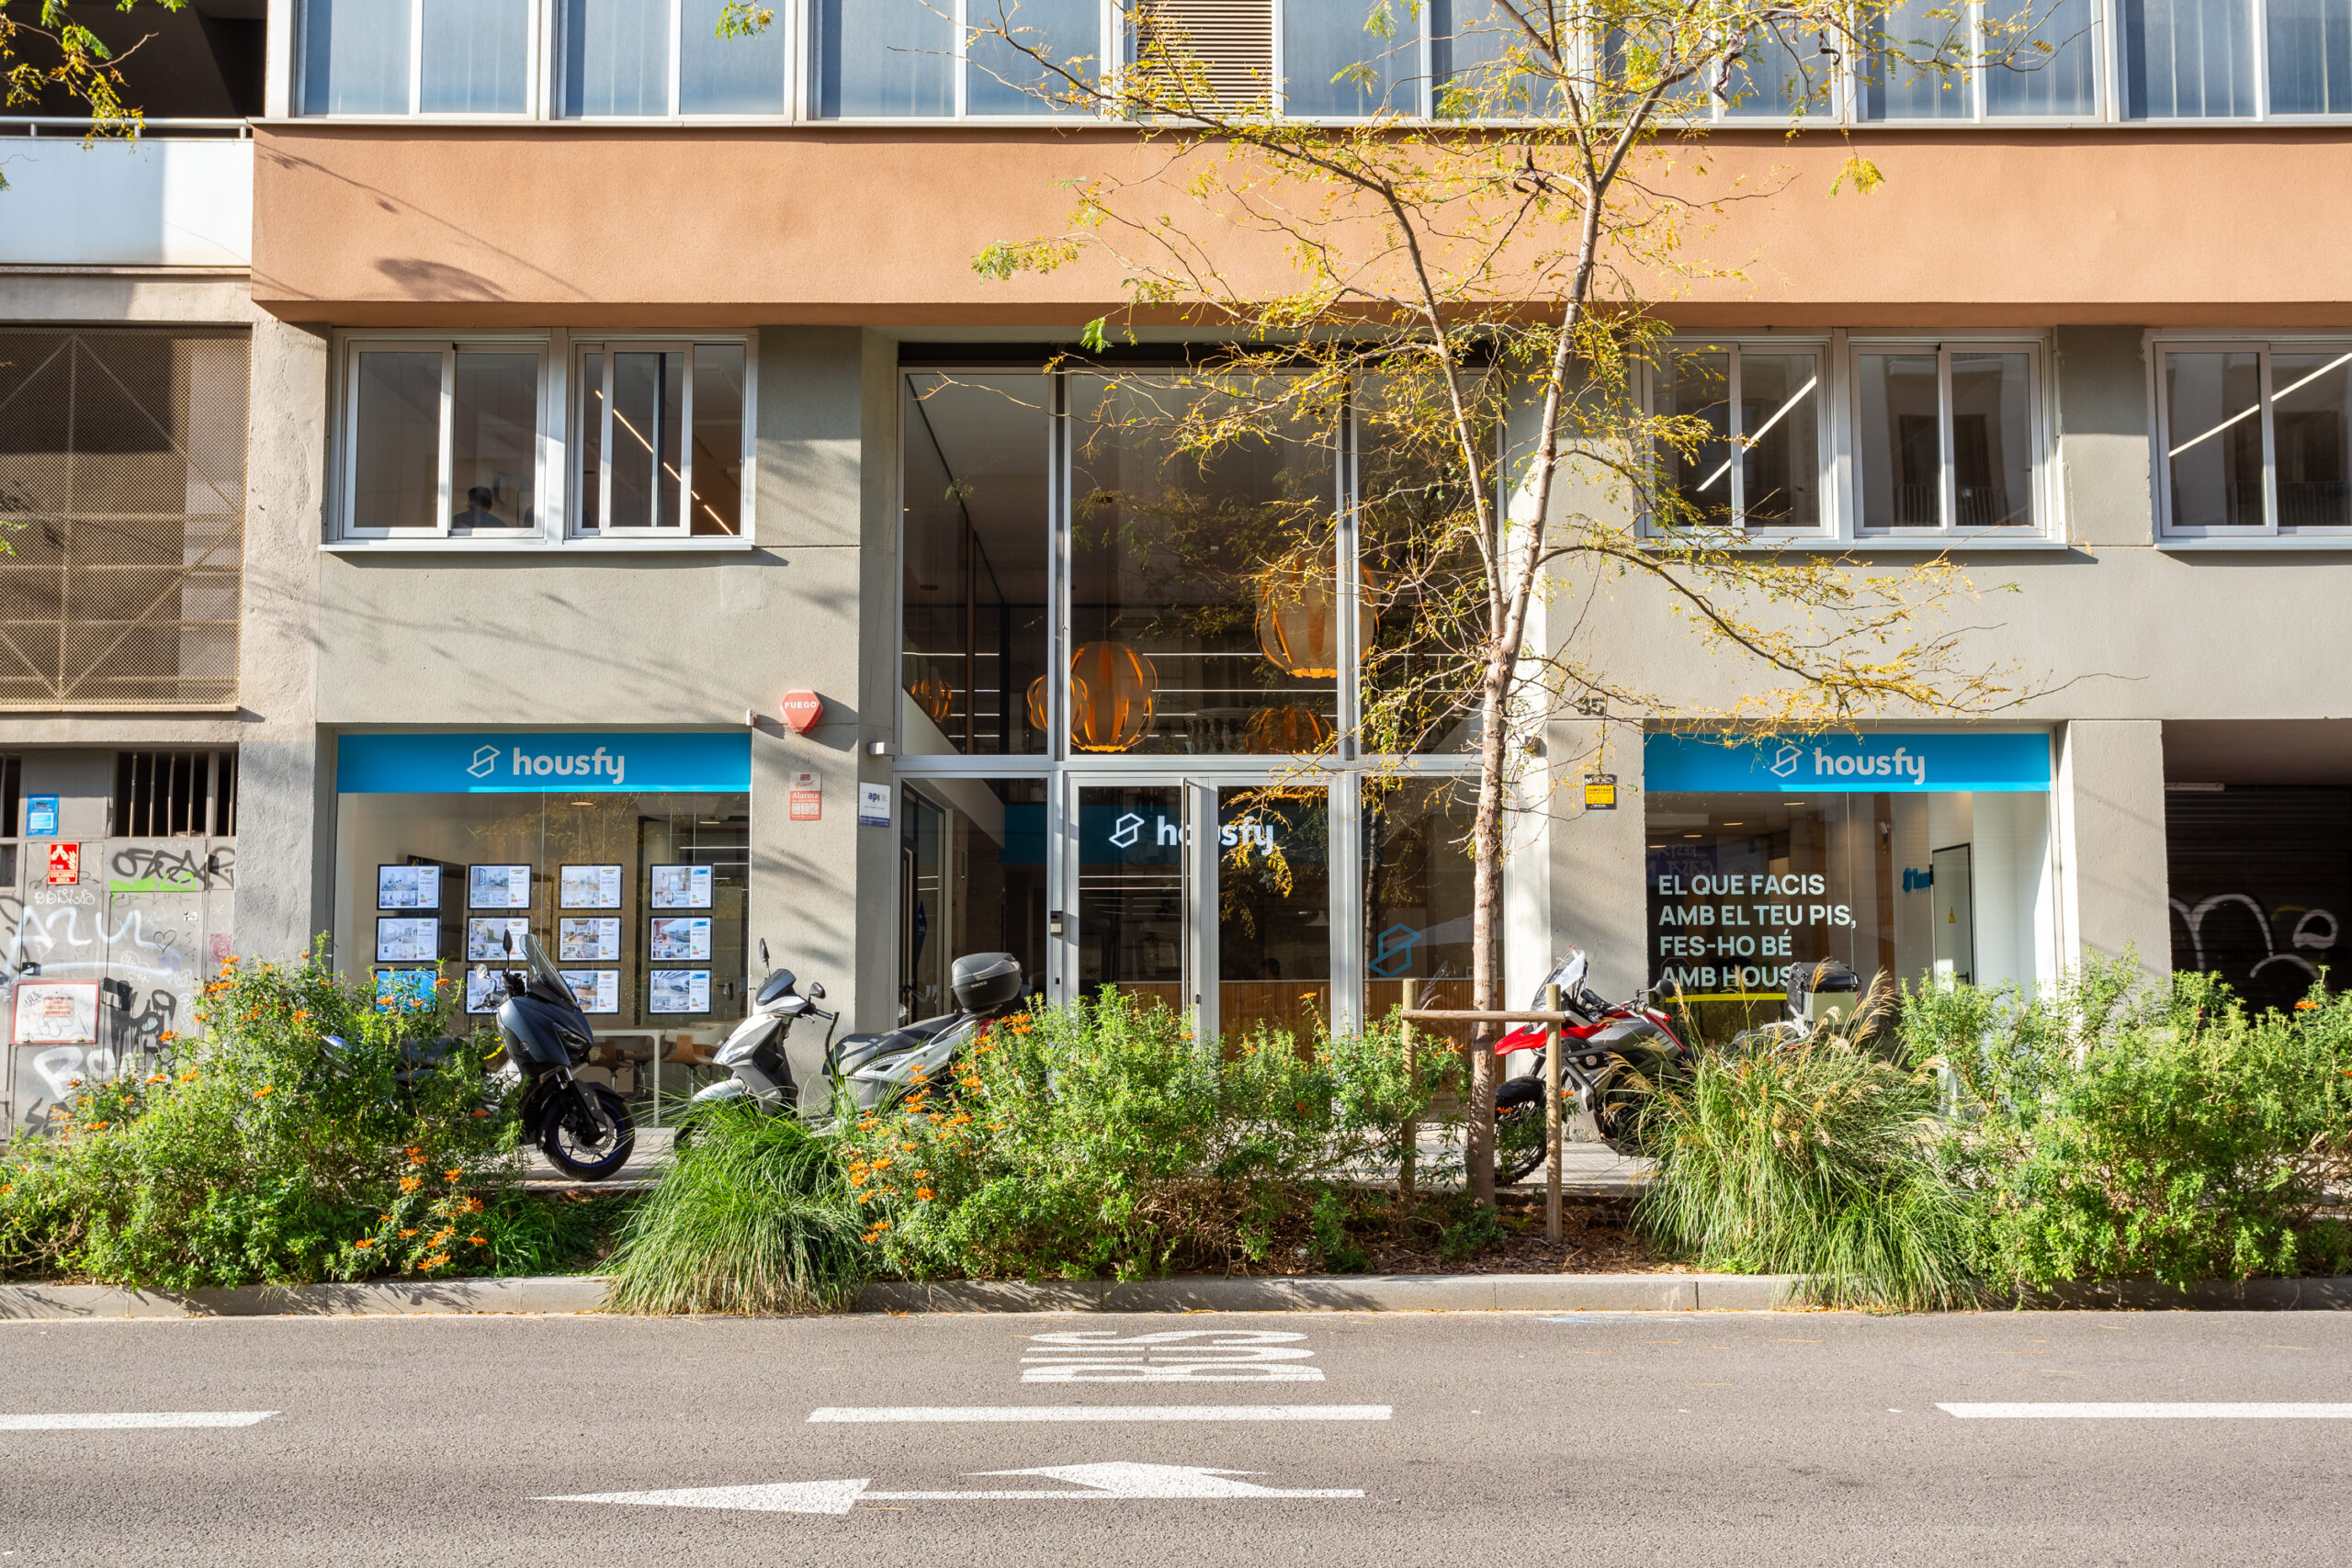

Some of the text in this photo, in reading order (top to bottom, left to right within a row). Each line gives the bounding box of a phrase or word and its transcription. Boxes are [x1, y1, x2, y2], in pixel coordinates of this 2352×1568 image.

[784, 701, 817, 709] FUEGO
[513, 746, 625, 785] housfy
[1815, 746, 1926, 785] housfy
[1157, 815, 1273, 856] hsfy
[1658, 874, 1826, 896] EL QUE FACIS
[1658, 905, 1857, 929] AMB EL TEU PIS,
[1659, 929, 1792, 956] FES-HO BÉ
[1662, 966, 1792, 987] AMB HOUS
[1020, 1329, 1326, 1382] BUS
